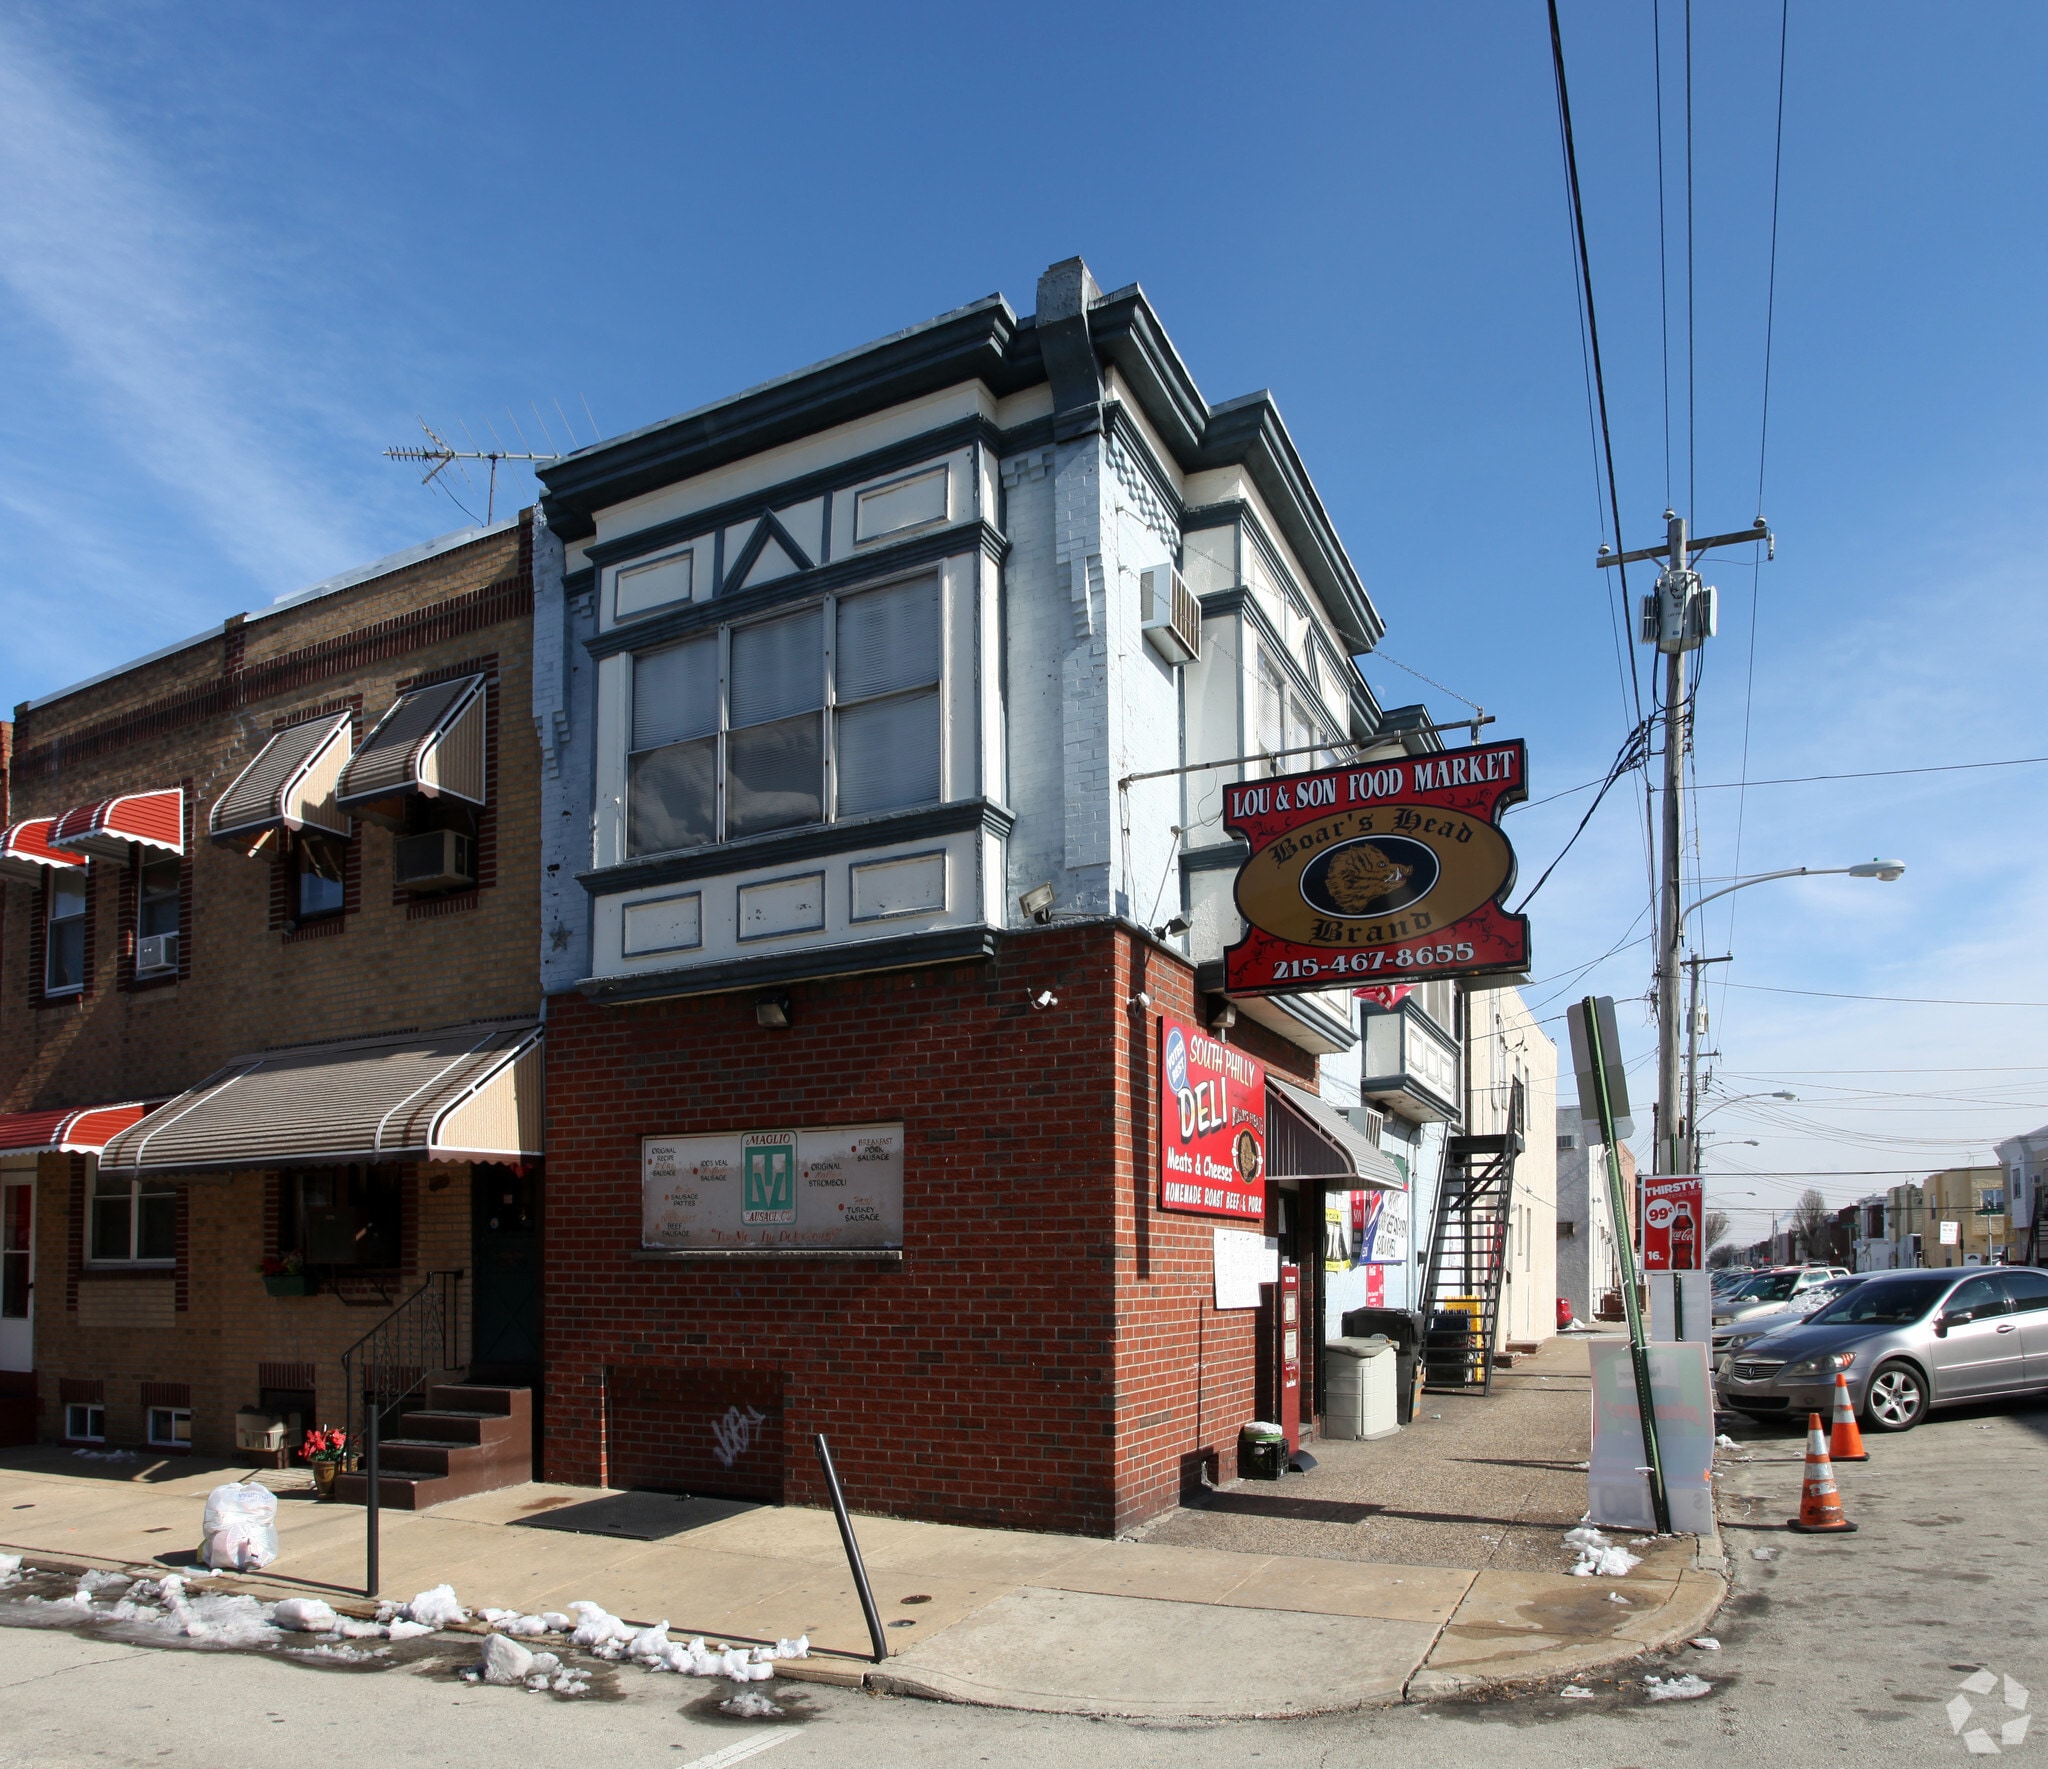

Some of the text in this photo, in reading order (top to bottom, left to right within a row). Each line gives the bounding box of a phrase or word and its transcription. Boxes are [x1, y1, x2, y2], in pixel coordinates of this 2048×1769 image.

[1233, 750, 1515, 818] LOU & SON FOOD MARKET
[1270, 808, 1473, 869] Boar's Head
[1308, 911, 1432, 944] Brand
[1272, 942, 1475, 980] 215-467-8655
[1189, 1034, 1255, 1088] SOUTH PHILLY
[1178, 1076, 1228, 1142] DELI
[746, 1133, 790, 1145] MAGLIO
[810, 1162, 842, 1171] ORIGINAL
[858, 1154, 890, 1162] SAUSAGE
[1167, 1146, 1233, 1182] Meats & Cheeses
[809, 1178, 846, 1187] STROMBOLI
[1165, 1181, 1202, 1205] HOMEMADE
[1204, 1187, 1224, 1209] ROAST
[1226, 1191, 1239, 1211] BEEF
[1248, 1197, 1262, 1214] PORK
[844, 1213, 880, 1222] SAUSAGE
[1649, 1206, 1673, 1221] 99¢
[1648, 1251, 1660, 1261] 16
